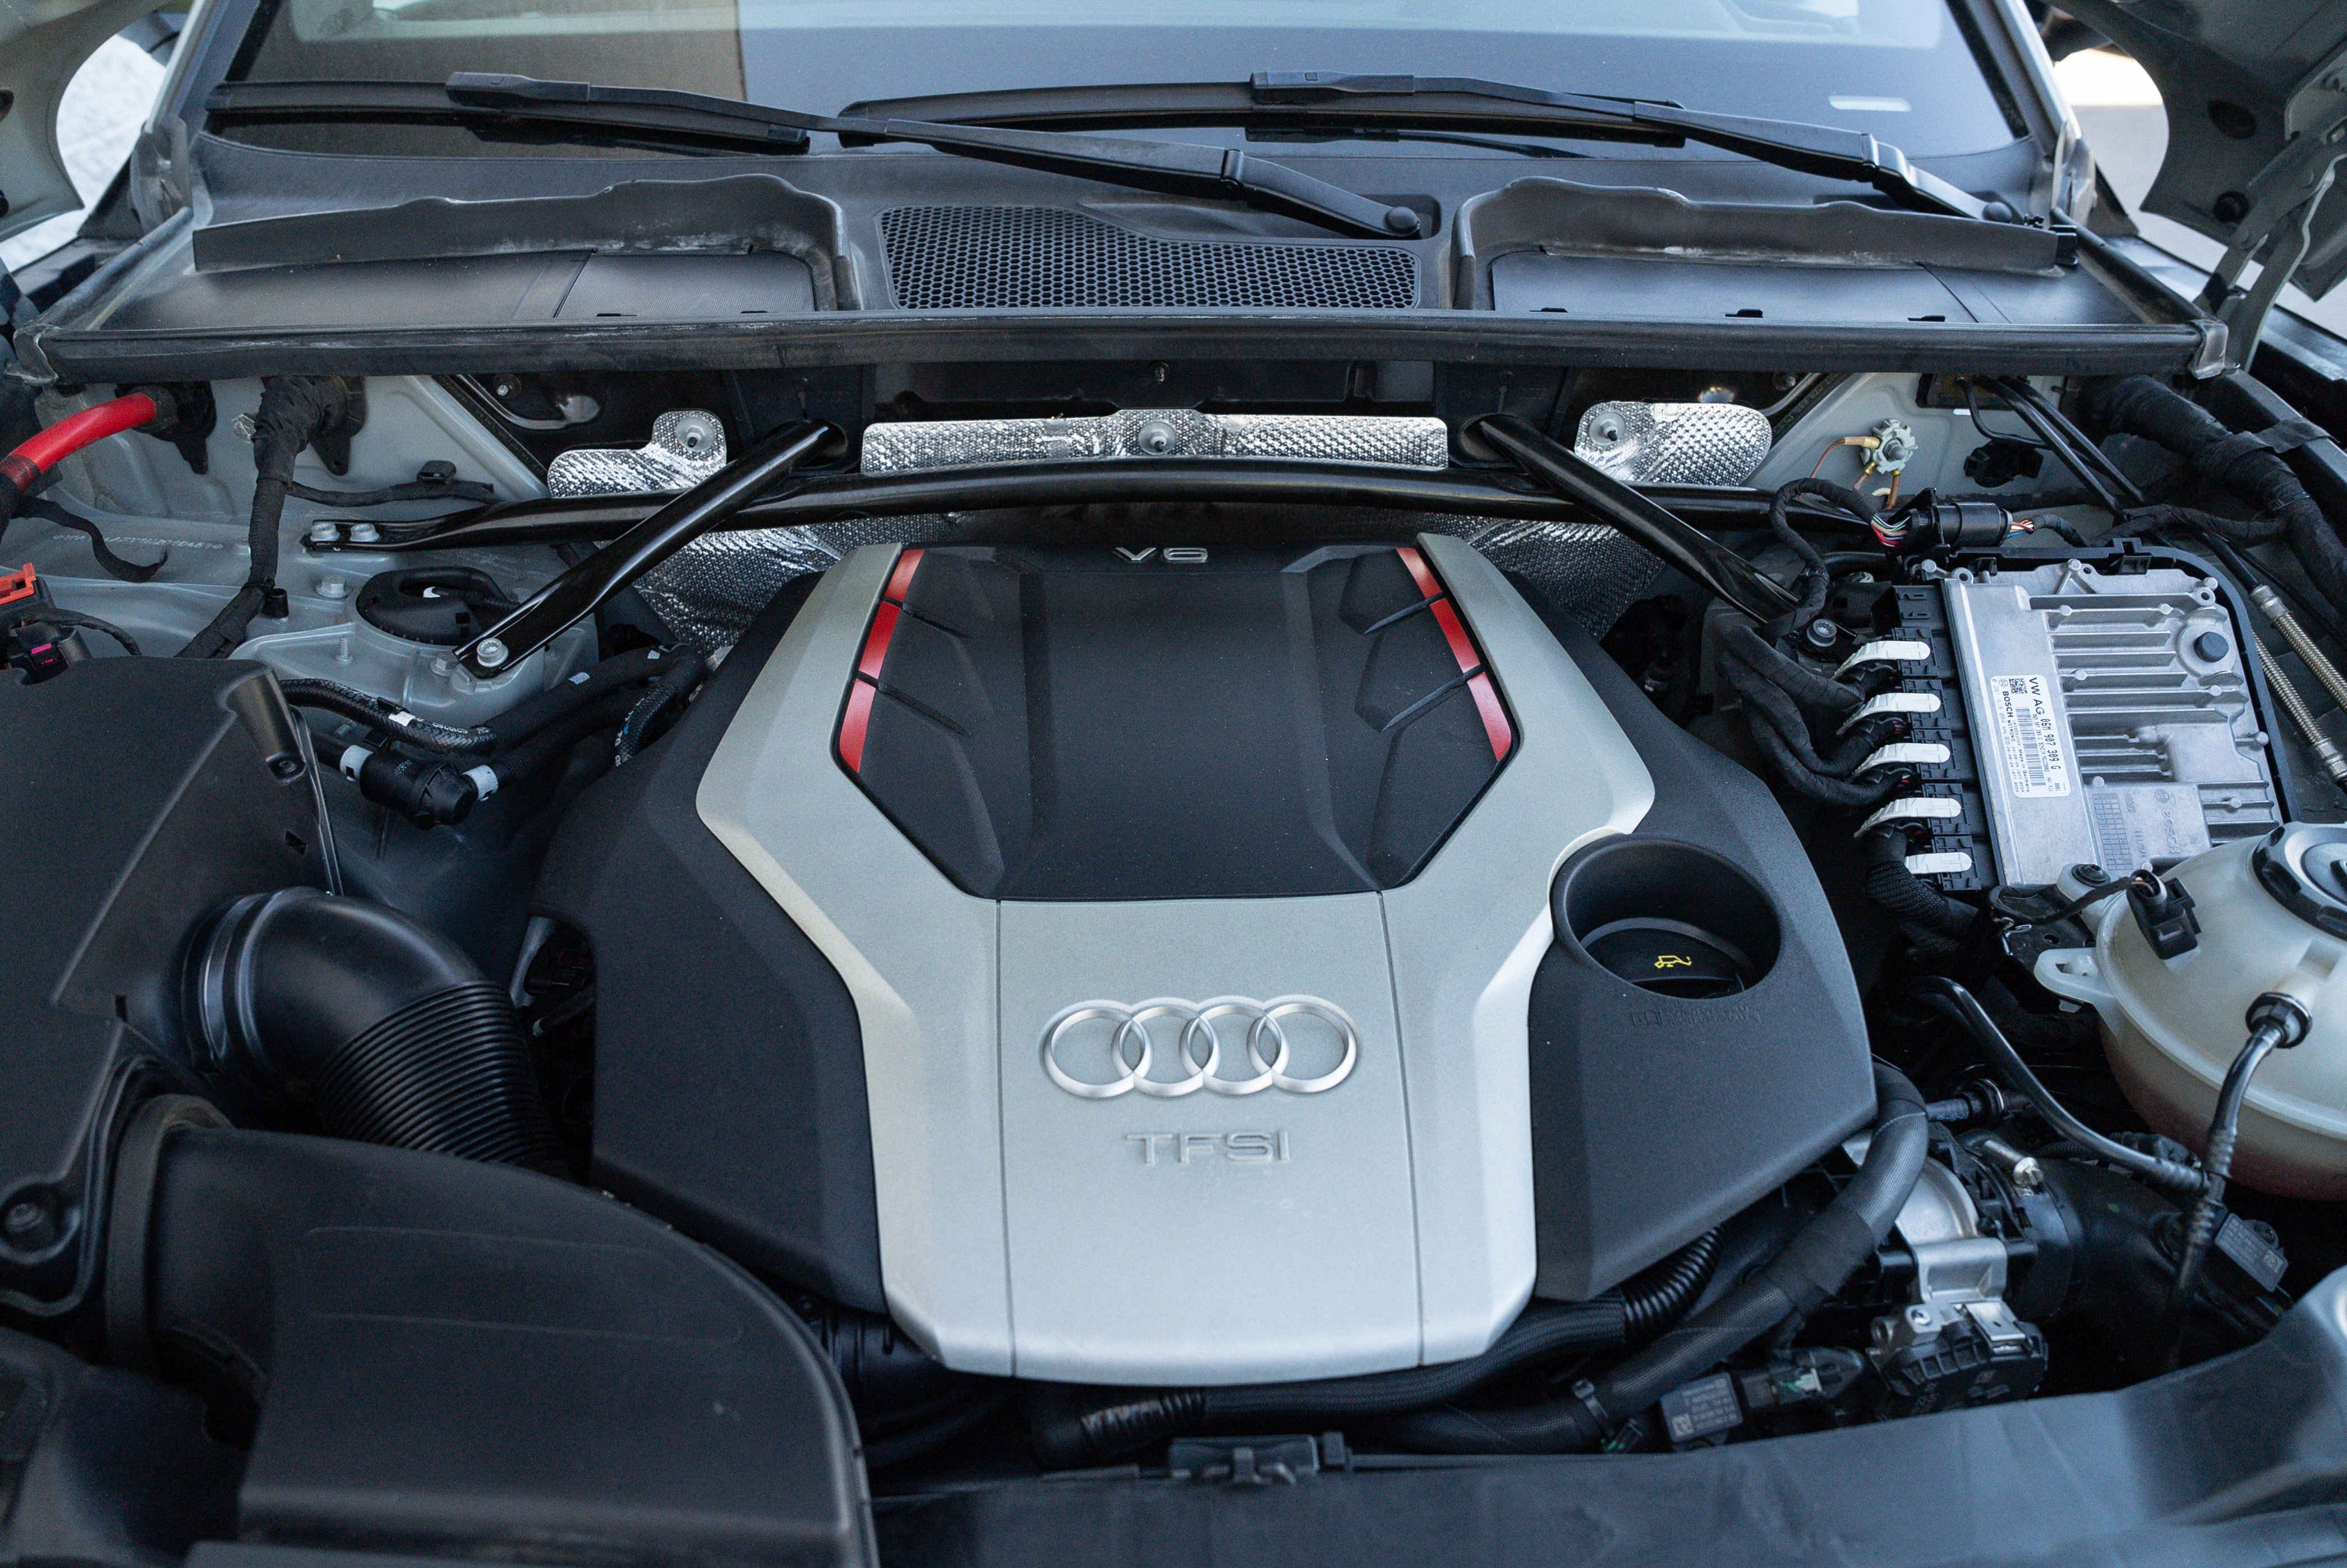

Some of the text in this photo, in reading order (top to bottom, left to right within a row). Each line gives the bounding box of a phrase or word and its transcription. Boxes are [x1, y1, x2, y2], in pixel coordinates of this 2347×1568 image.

[1113, 546, 1209, 564] V6
[2002, 691, 2013, 717] BOSCH
[2029, 677, 2045, 715] VW AG
[2041, 718, 2052, 730] 06M
[2044, 734, 2055, 746] 907
[2047, 749, 2059, 761] 309
[2022, 770, 2030, 792] Germany
[2161, 808, 2180, 854] BOSCH
[1125, 1129, 1291, 1165] TFSI
